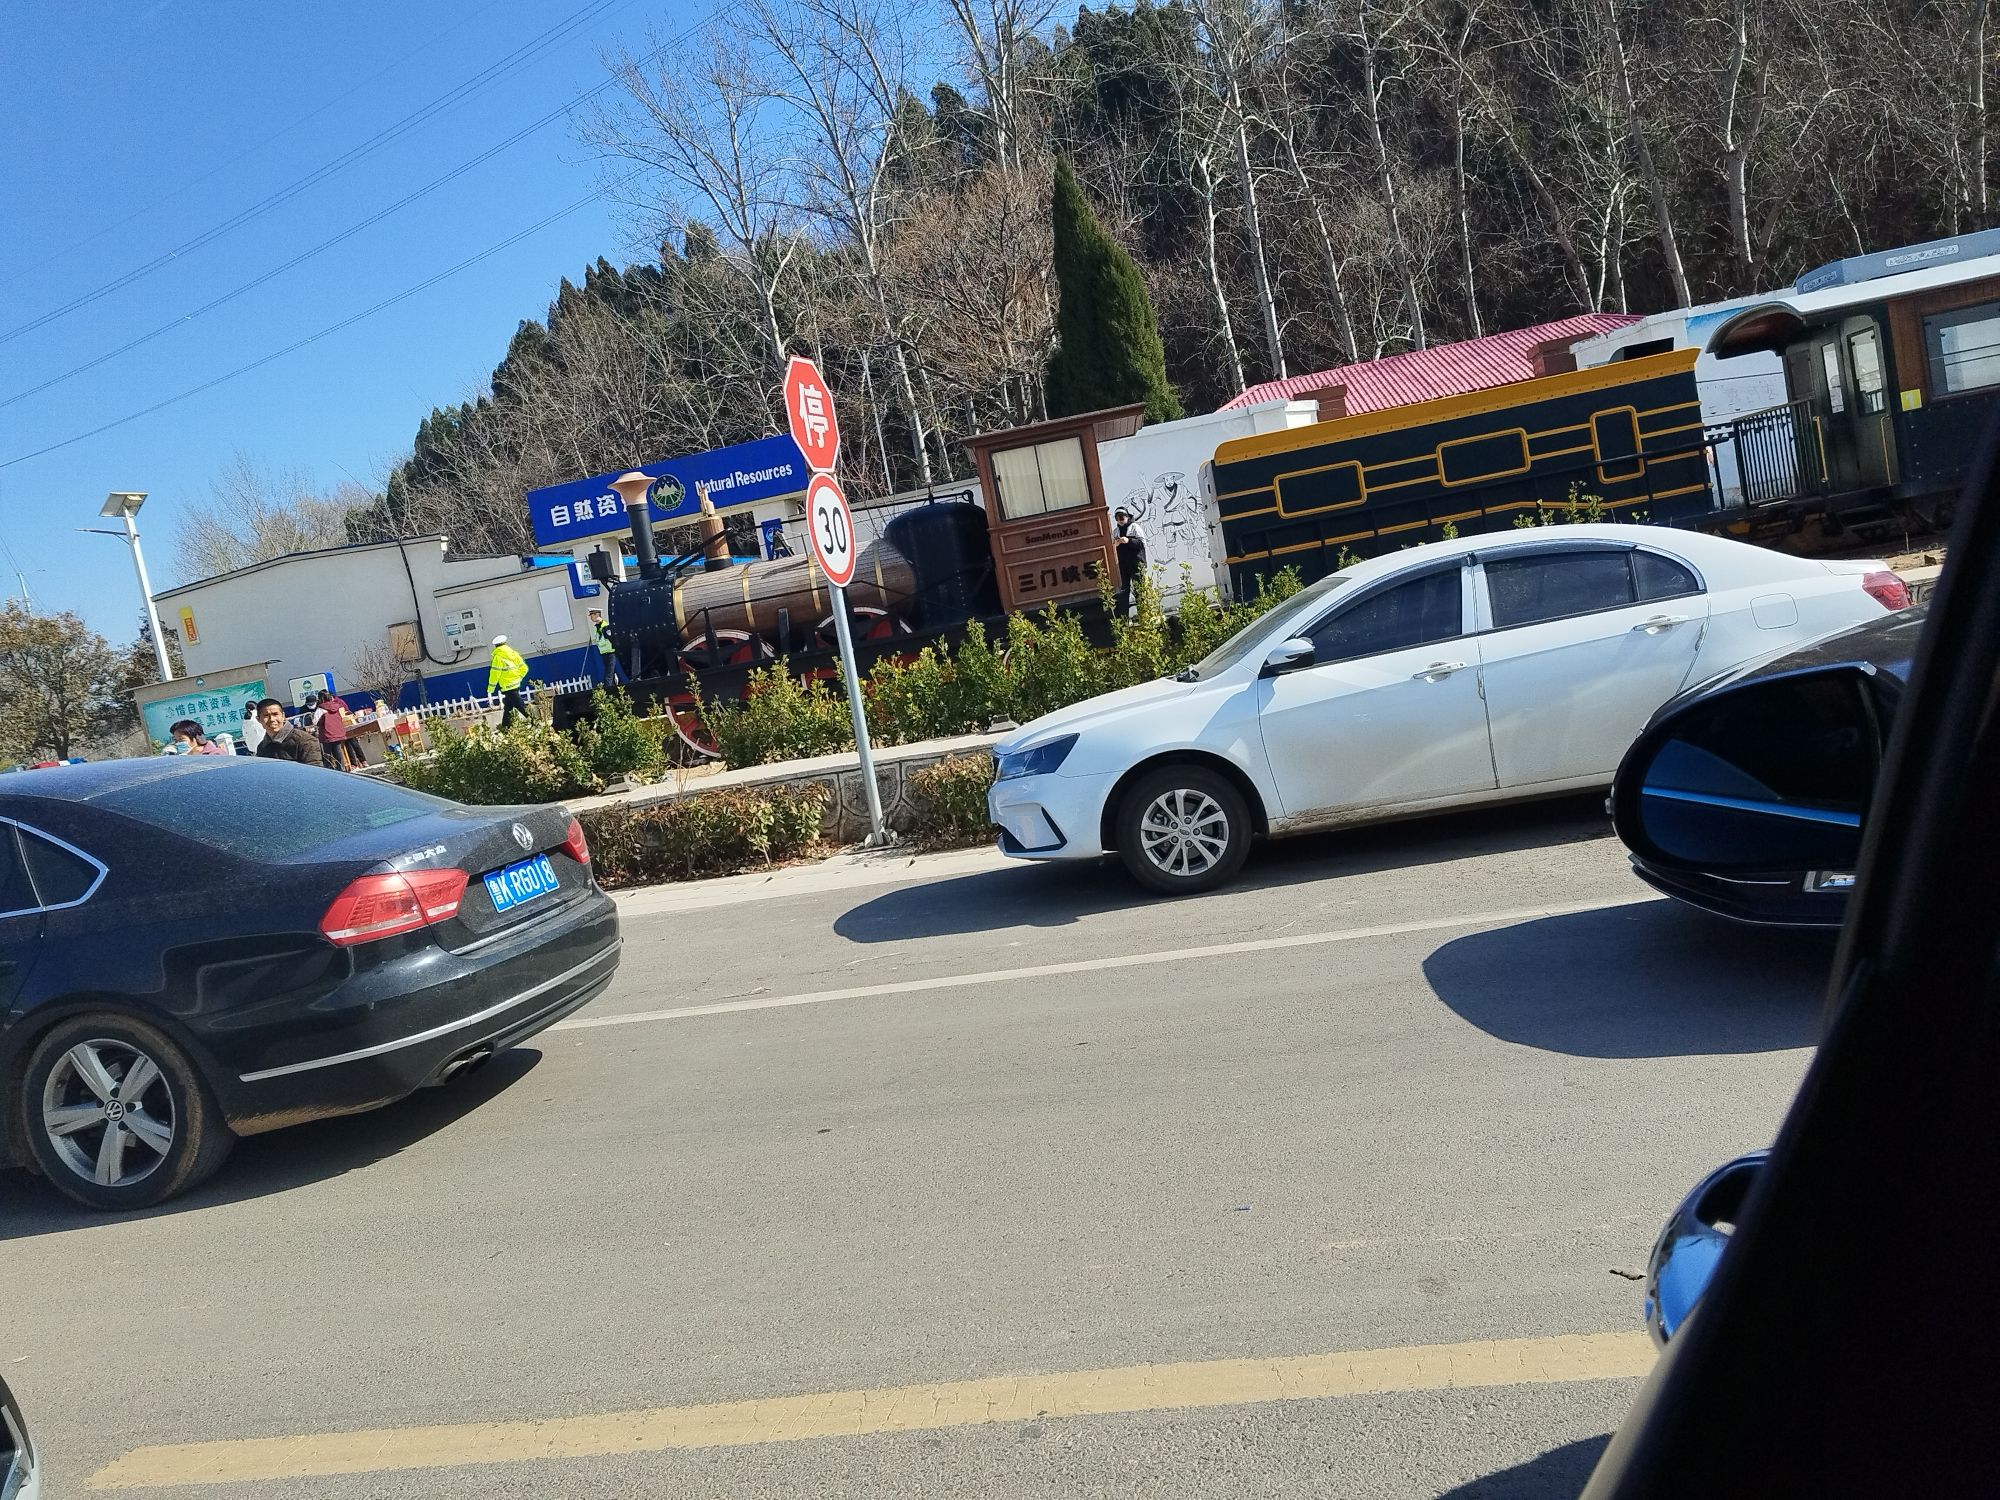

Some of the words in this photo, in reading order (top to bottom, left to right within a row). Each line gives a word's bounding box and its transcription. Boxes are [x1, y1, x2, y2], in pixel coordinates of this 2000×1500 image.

[799, 382, 829, 449] 停
[695, 473, 735, 497] Natural
[735, 464, 793, 487] Resources
[550, 494, 628, 527] 自然资
[818, 506, 846, 554] 30
